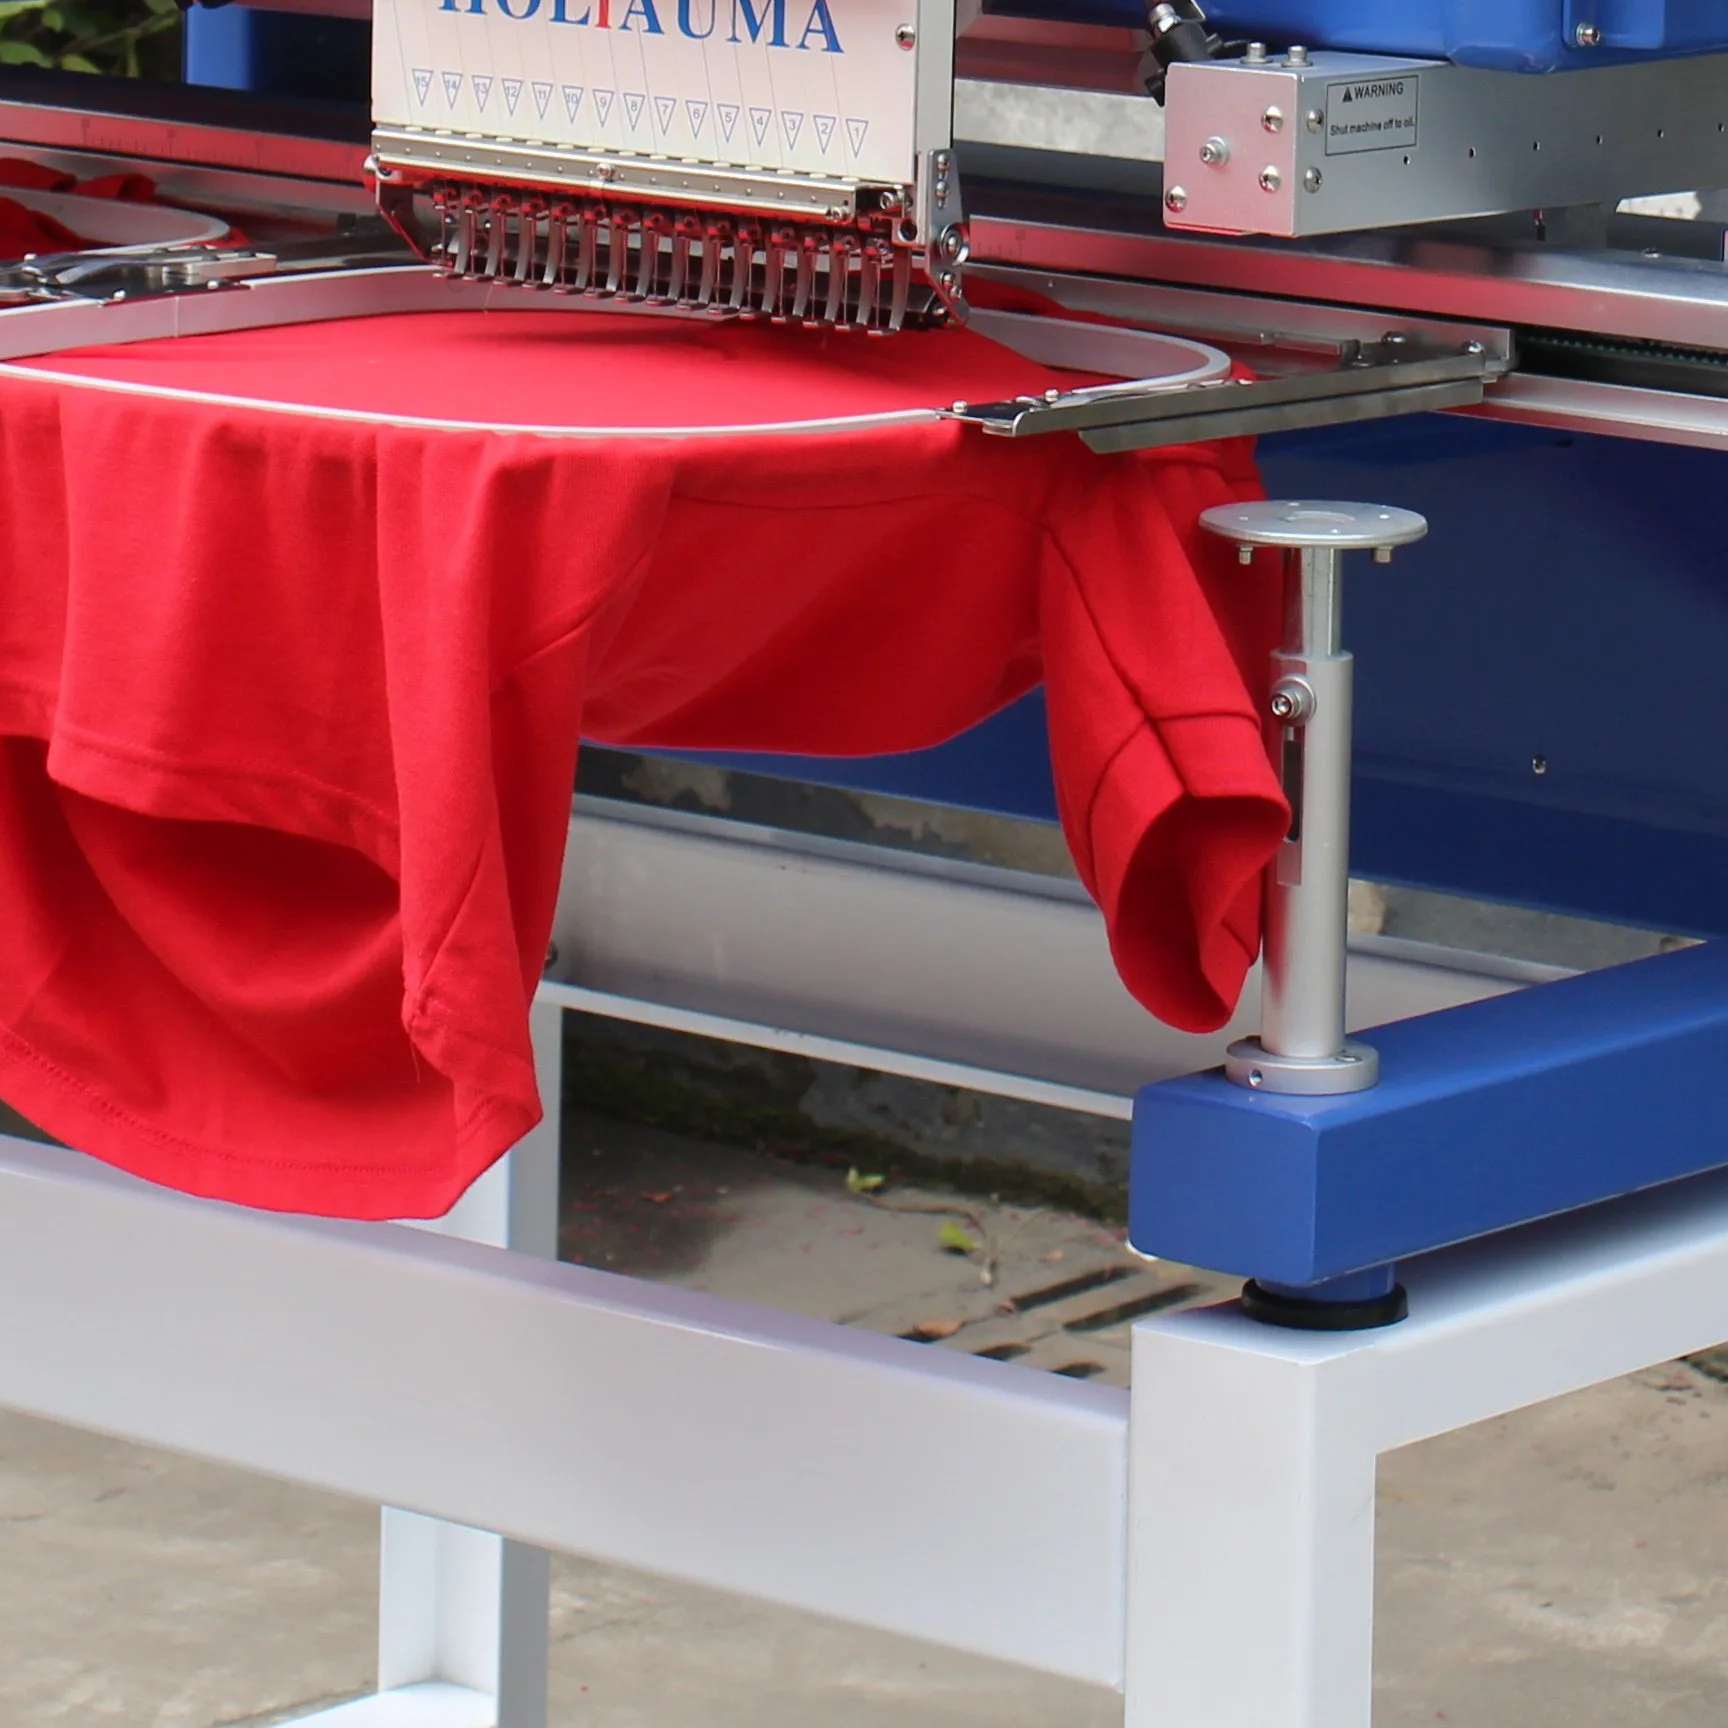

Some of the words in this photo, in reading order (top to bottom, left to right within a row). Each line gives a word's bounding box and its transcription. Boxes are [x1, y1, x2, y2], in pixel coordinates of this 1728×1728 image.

[1354, 81, 1404, 100] WARNING
[415, 75, 427, 87] 15
[445, 78, 457, 90] 14
[476, 82, 487, 93] 13
[505, 85, 517, 97] 12
[537, 89, 546, 100] 11
[566, 92, 578, 104] 10
[600, 96, 607, 108] 9
[630, 100, 637, 112] 8
[661, 103, 669, 115] 7
[692, 108, 700, 120] 6
[724, 111, 732, 123] 5
[756, 115, 764, 127] 4
[788, 119, 796, 131] 3
[820, 122, 828, 134] 2
[1330, 123, 1348, 136] Shut
[1349, 120, 1382, 133] machine
[1383, 118, 1394, 130] off
[1395, 118, 1402, 128] to
